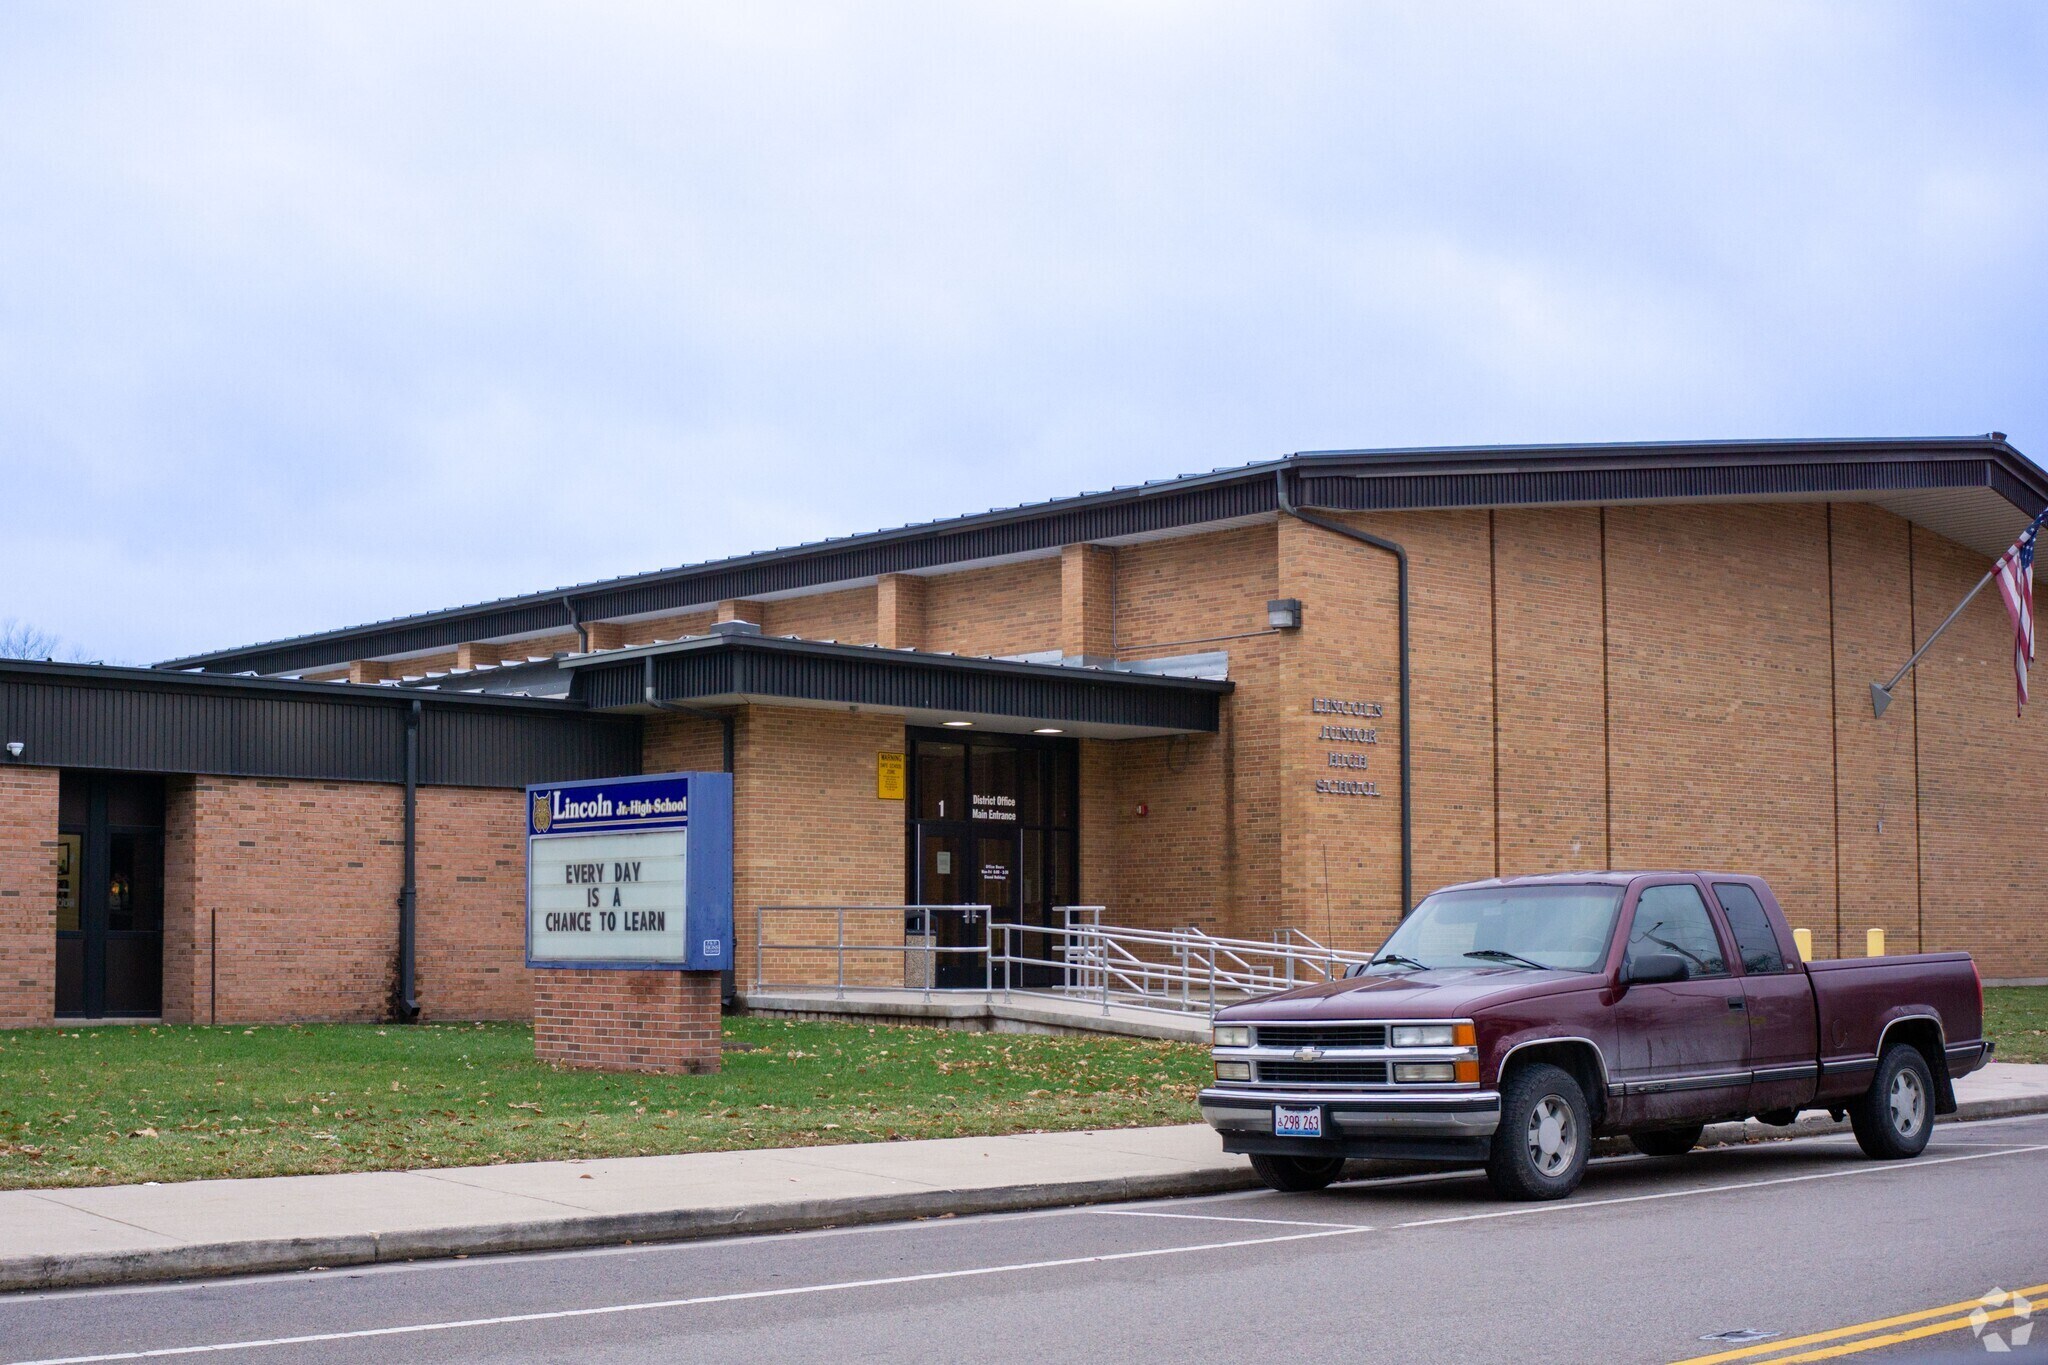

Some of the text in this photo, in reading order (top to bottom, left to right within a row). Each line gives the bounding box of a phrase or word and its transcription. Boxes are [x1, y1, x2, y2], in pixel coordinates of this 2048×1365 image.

[1313, 697, 1383, 718] LINCOLN
[1318, 725, 1377, 744] JUNIOR
[1328, 752, 1367, 770] HIGH
[1316, 778, 1380, 797] SCHOOL
[552, 790, 687, 820] Lincoln Jr. High School
[938, 800, 945, 817] 1
[972, 794, 1016, 807] District Office
[972, 808, 1017, 821] Main Entrance
[566, 861, 641, 884] EVERY DAY
[587, 887, 621, 907] IS A
[545, 910, 665, 932] CHANCE TO LEARN
[1283, 1115, 1319, 1130] 298 263
